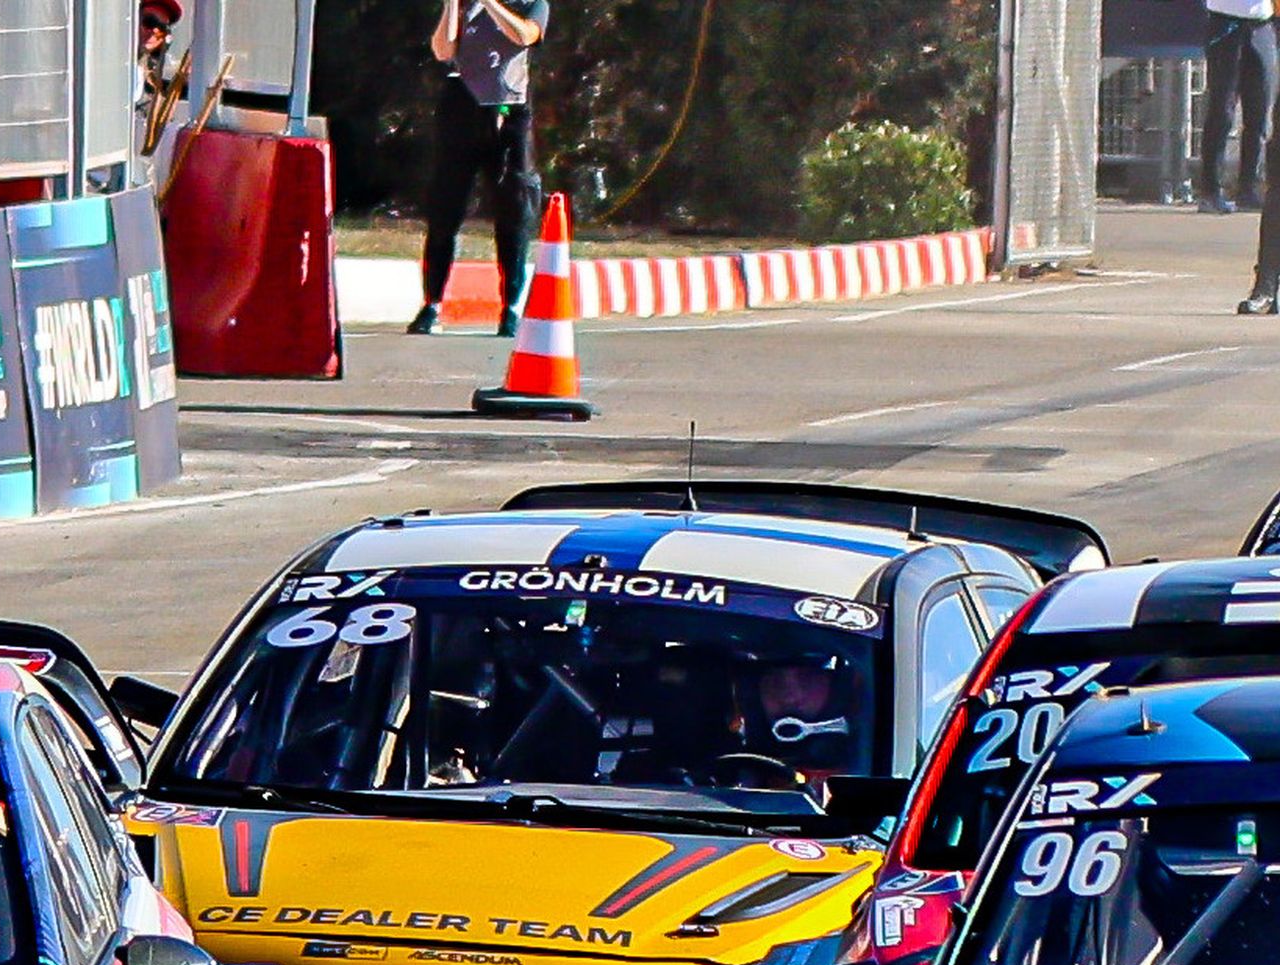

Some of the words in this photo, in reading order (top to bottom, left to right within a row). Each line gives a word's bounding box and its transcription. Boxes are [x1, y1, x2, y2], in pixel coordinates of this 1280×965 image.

[293, 570, 398, 602] RX
[459, 566, 725, 605] GRÖNHOLM
[797, 599, 878, 630] FIA
[266, 602, 417, 648] 68
[1006, 661, 1111, 701] RX
[967, 702, 1065, 773] 20
[1048, 773, 1162, 813] RX
[1014, 831, 1128, 897] 96
[197, 906, 267, 924] CE
[272, 906, 472, 932] DEALER
[488, 917, 632, 948] TEAM
[411, 951, 523, 965] ASCENDUM
